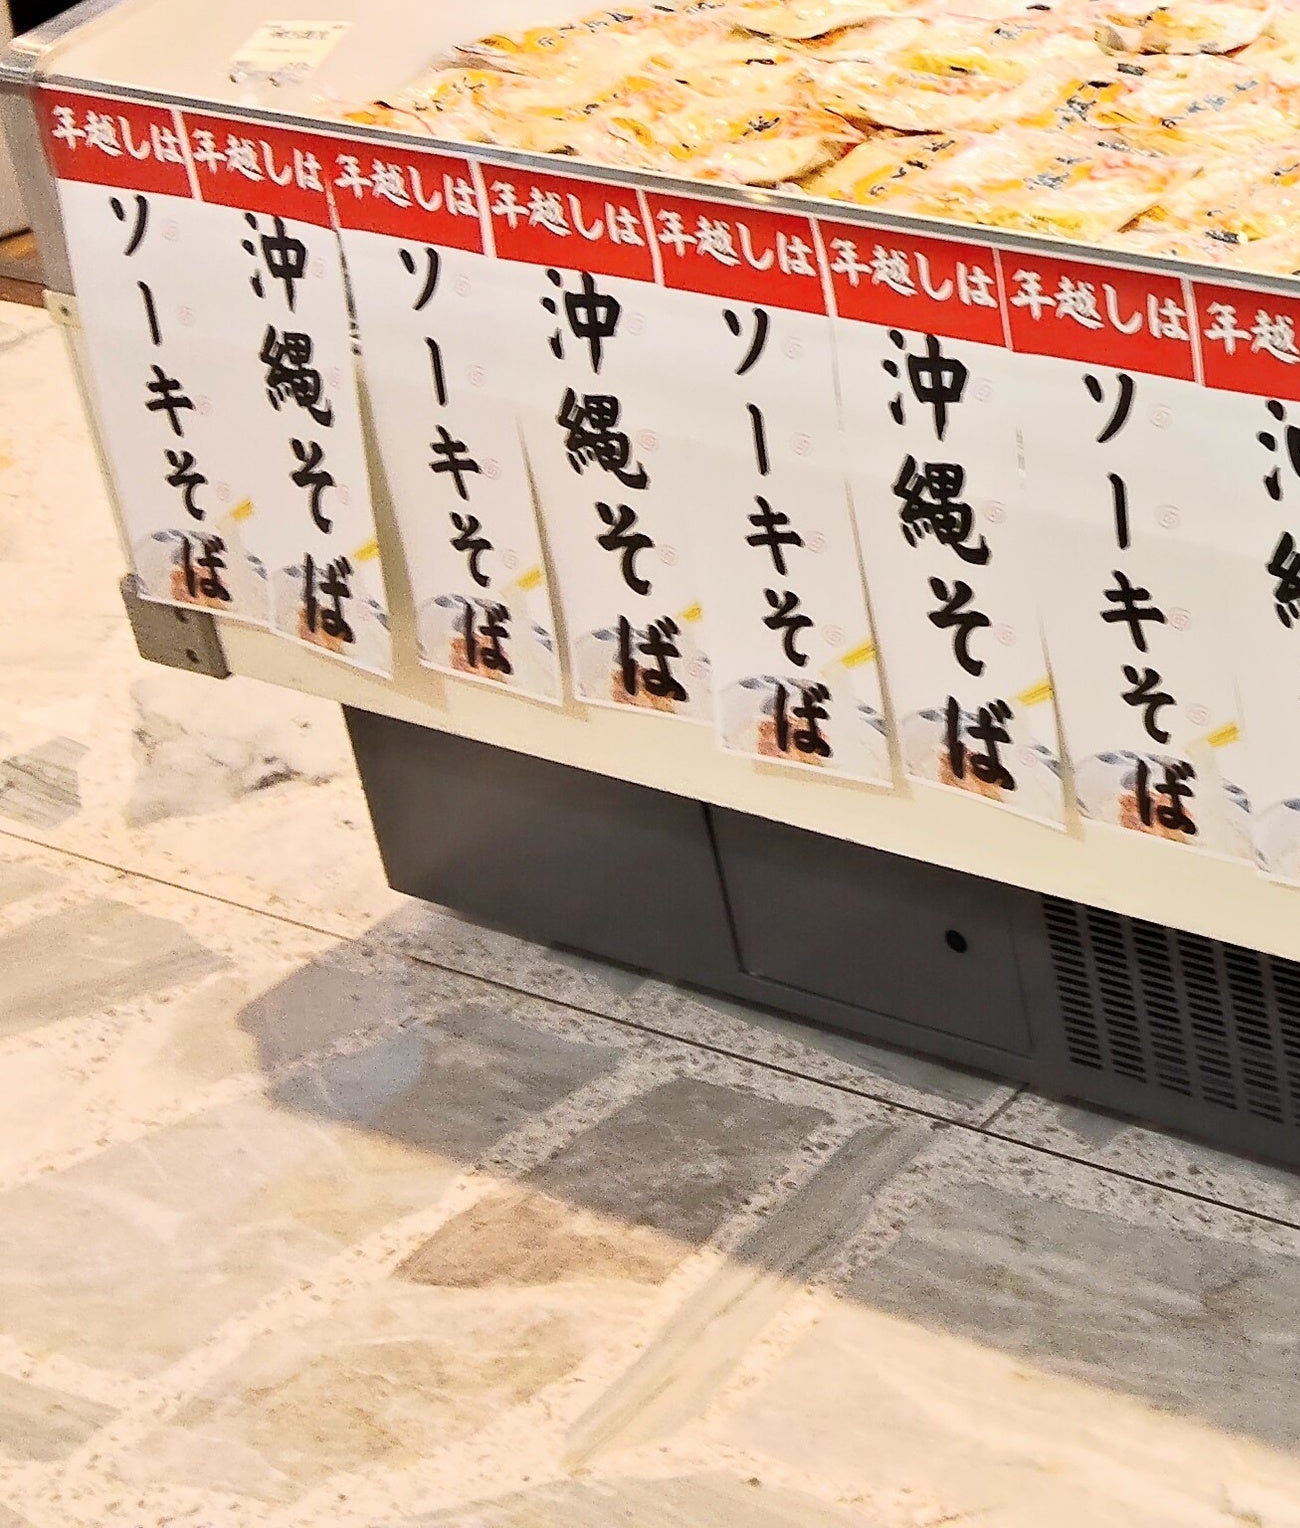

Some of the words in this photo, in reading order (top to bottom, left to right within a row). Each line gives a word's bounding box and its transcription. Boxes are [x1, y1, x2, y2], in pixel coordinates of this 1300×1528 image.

[51, 104, 185, 164] 年越しは
[191, 133, 326, 193] 年越しは
[334, 154, 479, 218] 年越しは
[489, 181, 646, 247] 年越しは
[655, 208, 817, 278] 年越しは
[829, 237, 998, 309] 年越しは
[1010, 268, 1188, 341] 年越しは
[109, 193, 231, 602] ソーキそば
[241, 212, 354, 645] 沖縄そば
[399, 246, 512, 676] ソーキそば
[540, 268, 689, 703] 沖縄そば
[722, 307, 835, 759] ソーキそば
[882, 328, 1019, 793] 沖縄そば
[1084, 372, 1200, 836] ソーキそば
